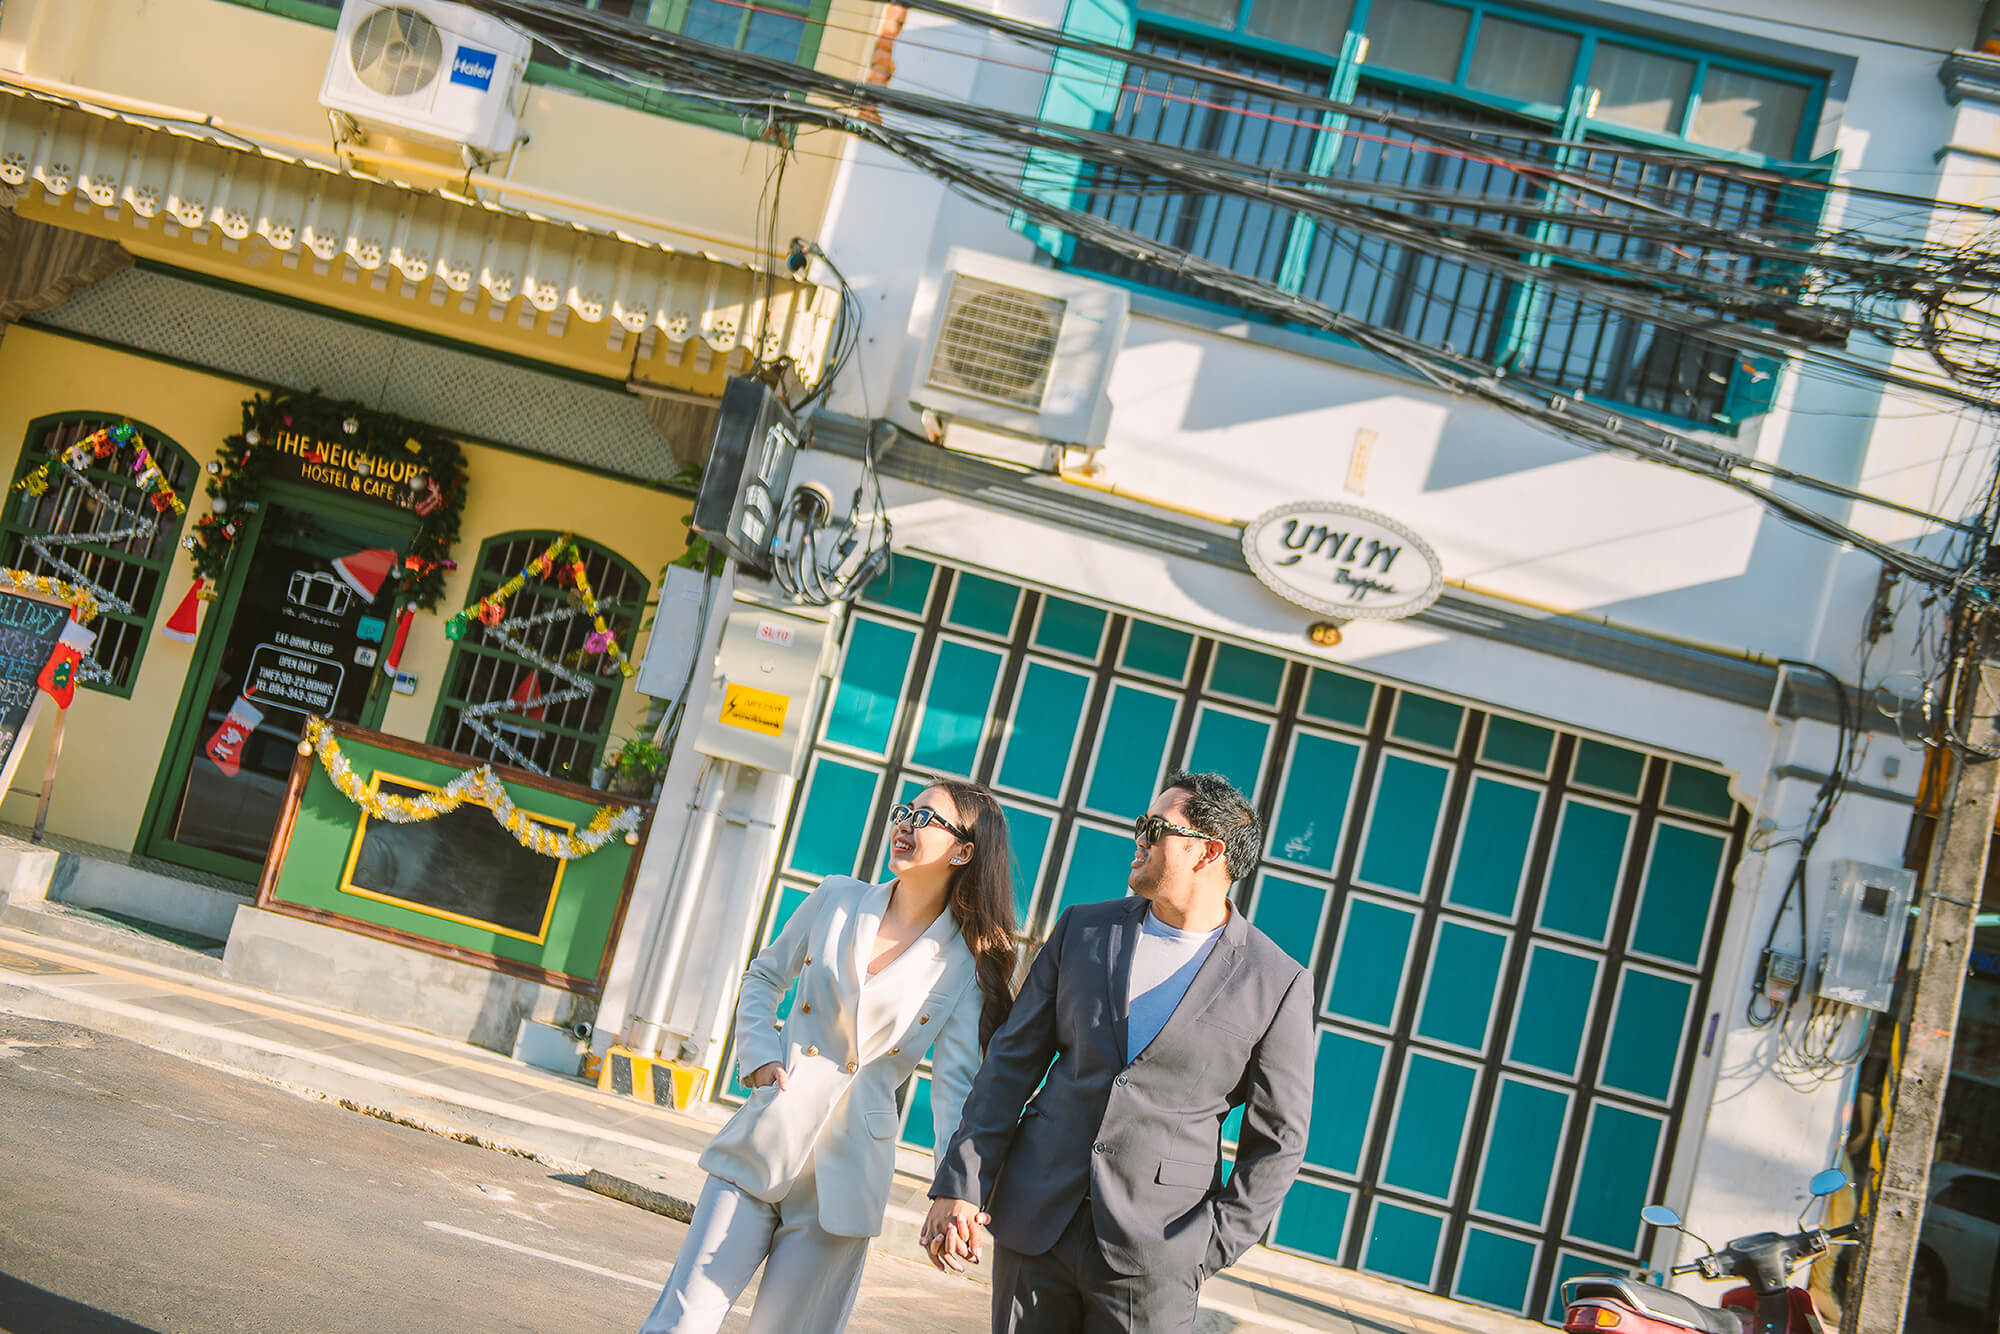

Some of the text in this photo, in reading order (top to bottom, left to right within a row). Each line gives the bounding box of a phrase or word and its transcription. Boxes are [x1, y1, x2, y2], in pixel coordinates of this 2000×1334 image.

[453, 57, 491, 80] Haier
[275, 431, 311, 459] THE
[302, 463, 394, 501] HOSTEL & CAFE
[278, 655, 318, 676] OPEN DAILY
